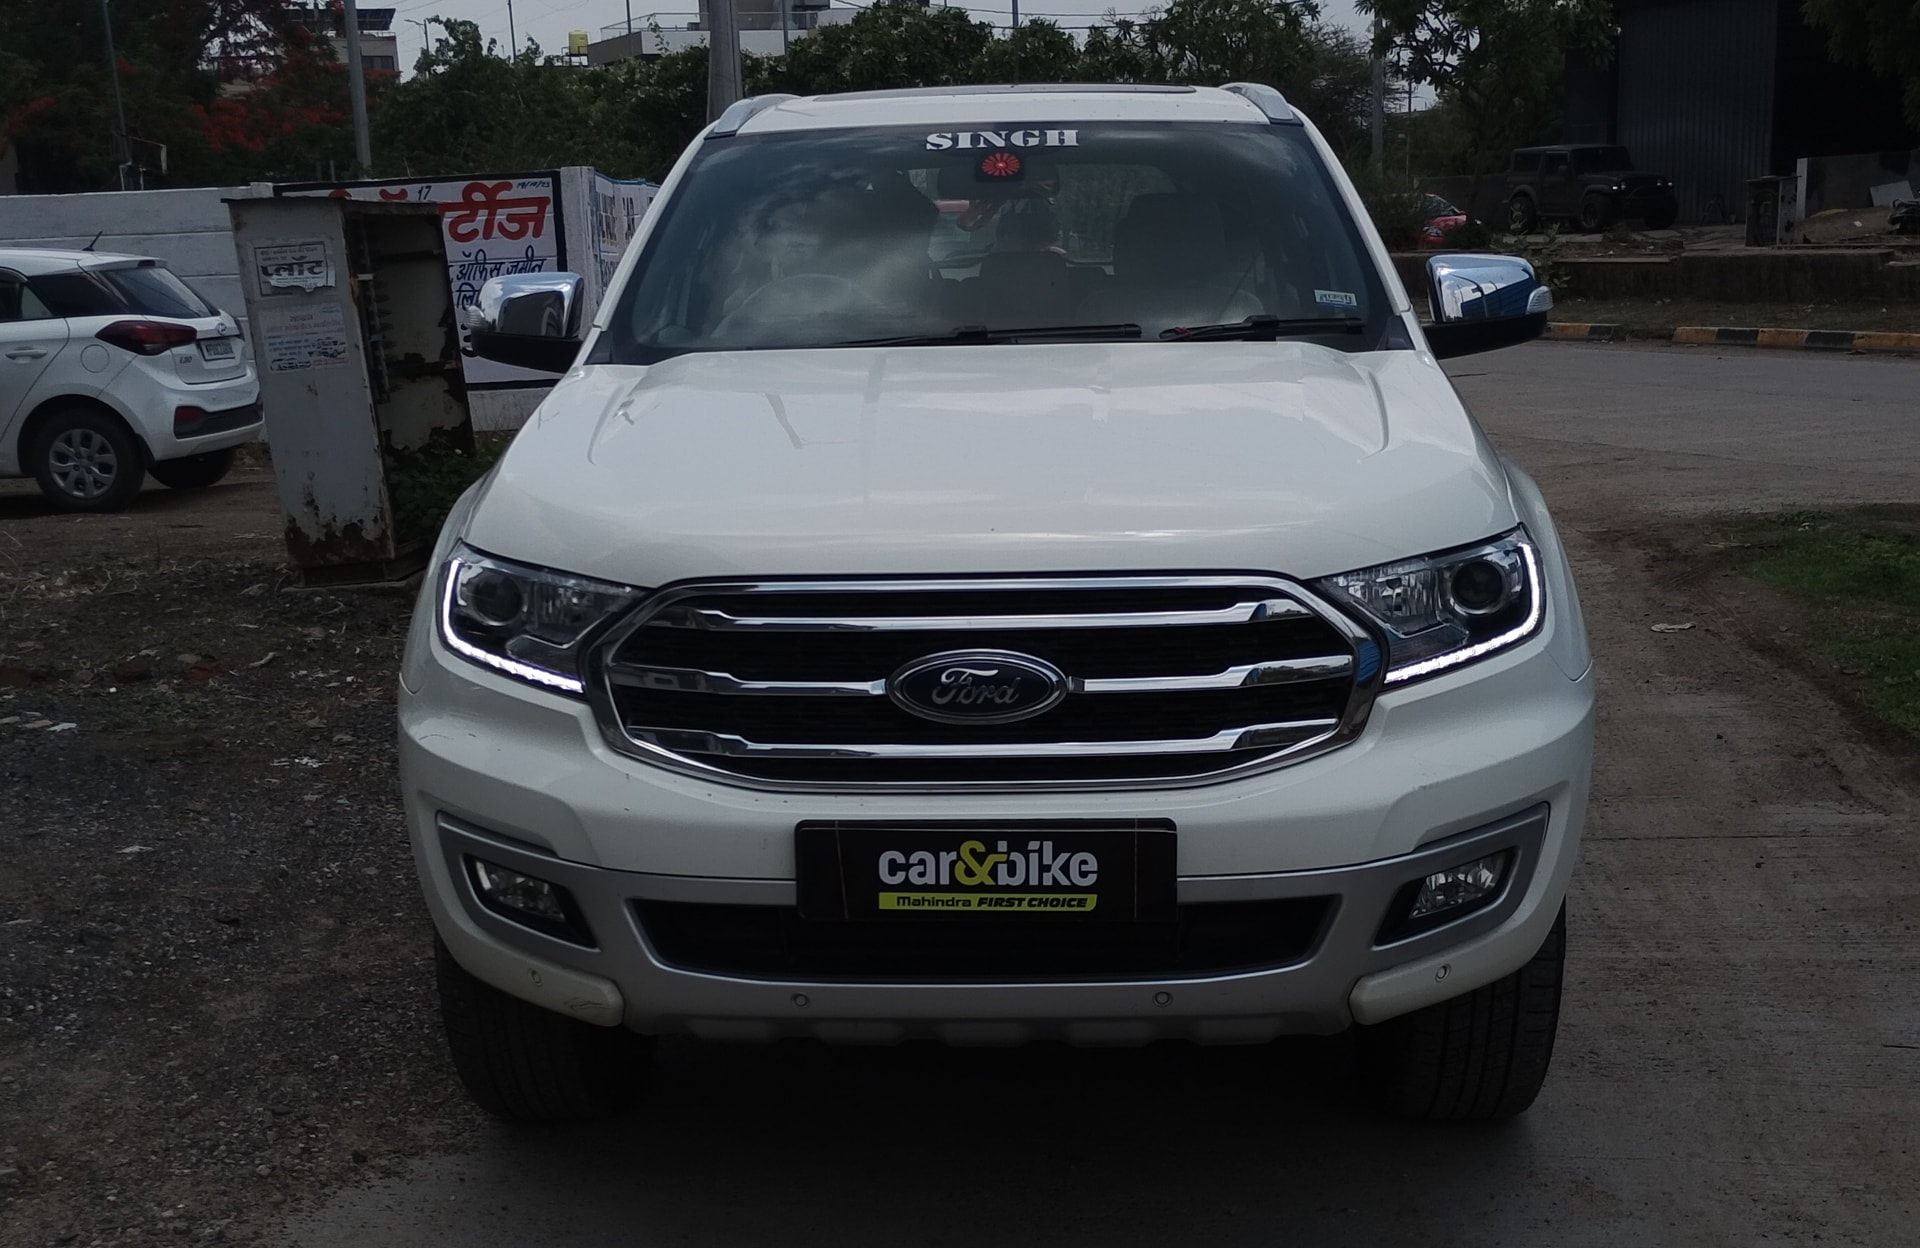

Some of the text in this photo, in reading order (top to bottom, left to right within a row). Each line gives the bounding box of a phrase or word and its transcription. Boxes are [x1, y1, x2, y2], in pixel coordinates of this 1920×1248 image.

[926, 130, 1079, 150] SINGH
[931, 667, 1021, 705] Ford
[878, 840, 1098, 886] car&bike
[896, 896, 1088, 909] Mahindra FIRST CHOICE
